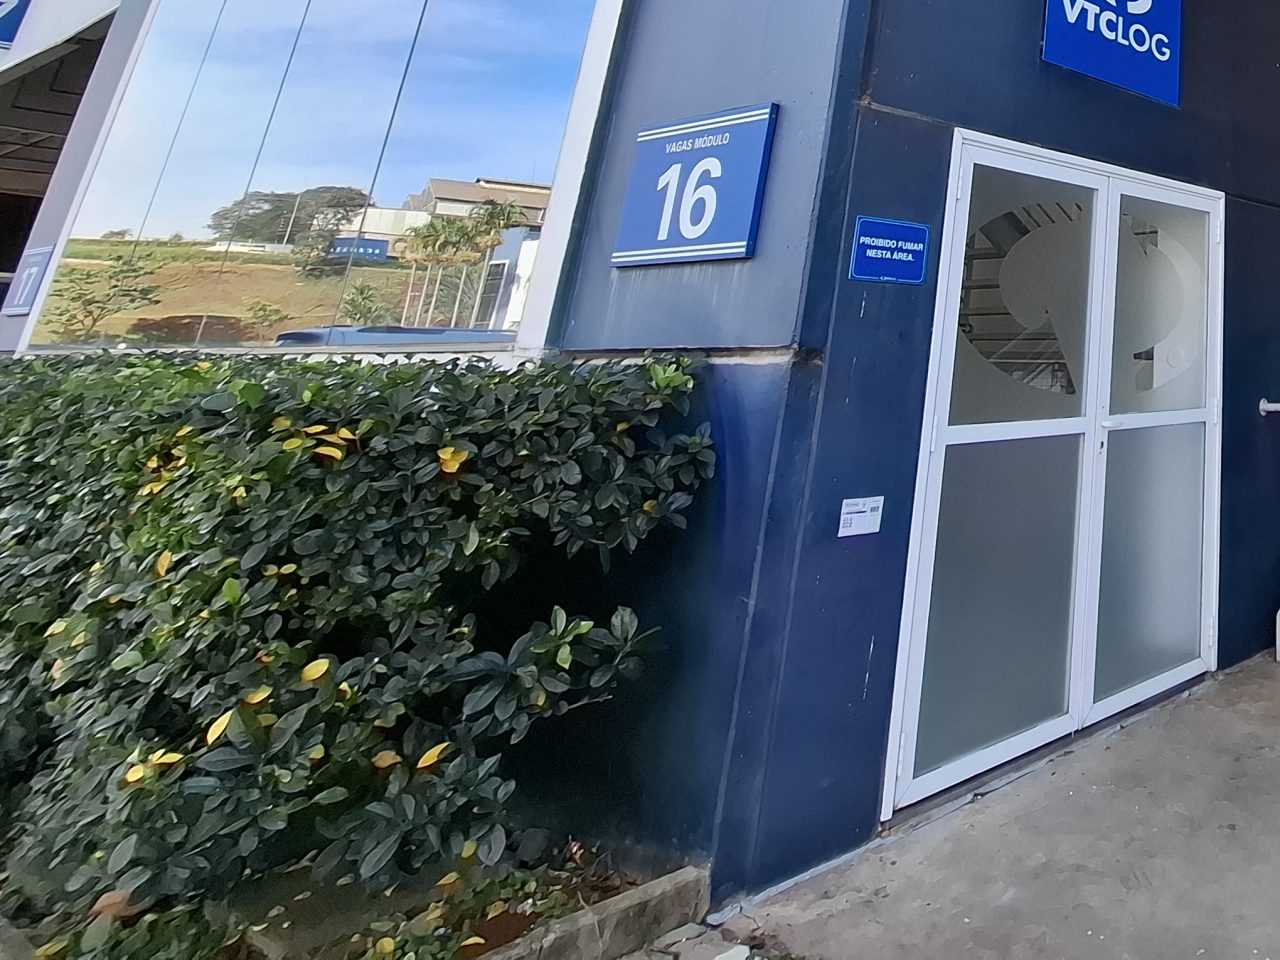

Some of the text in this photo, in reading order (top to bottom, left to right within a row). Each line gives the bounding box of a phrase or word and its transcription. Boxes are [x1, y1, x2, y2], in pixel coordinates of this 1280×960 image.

[665, 132, 730, 154] VAGAS MÓDULO
[656, 156, 722, 241] 16
[859, 236, 924, 252] PROIBIDO FUMAR
[866, 248, 892, 259] NESTA
[13, 266, 39, 305] 17
